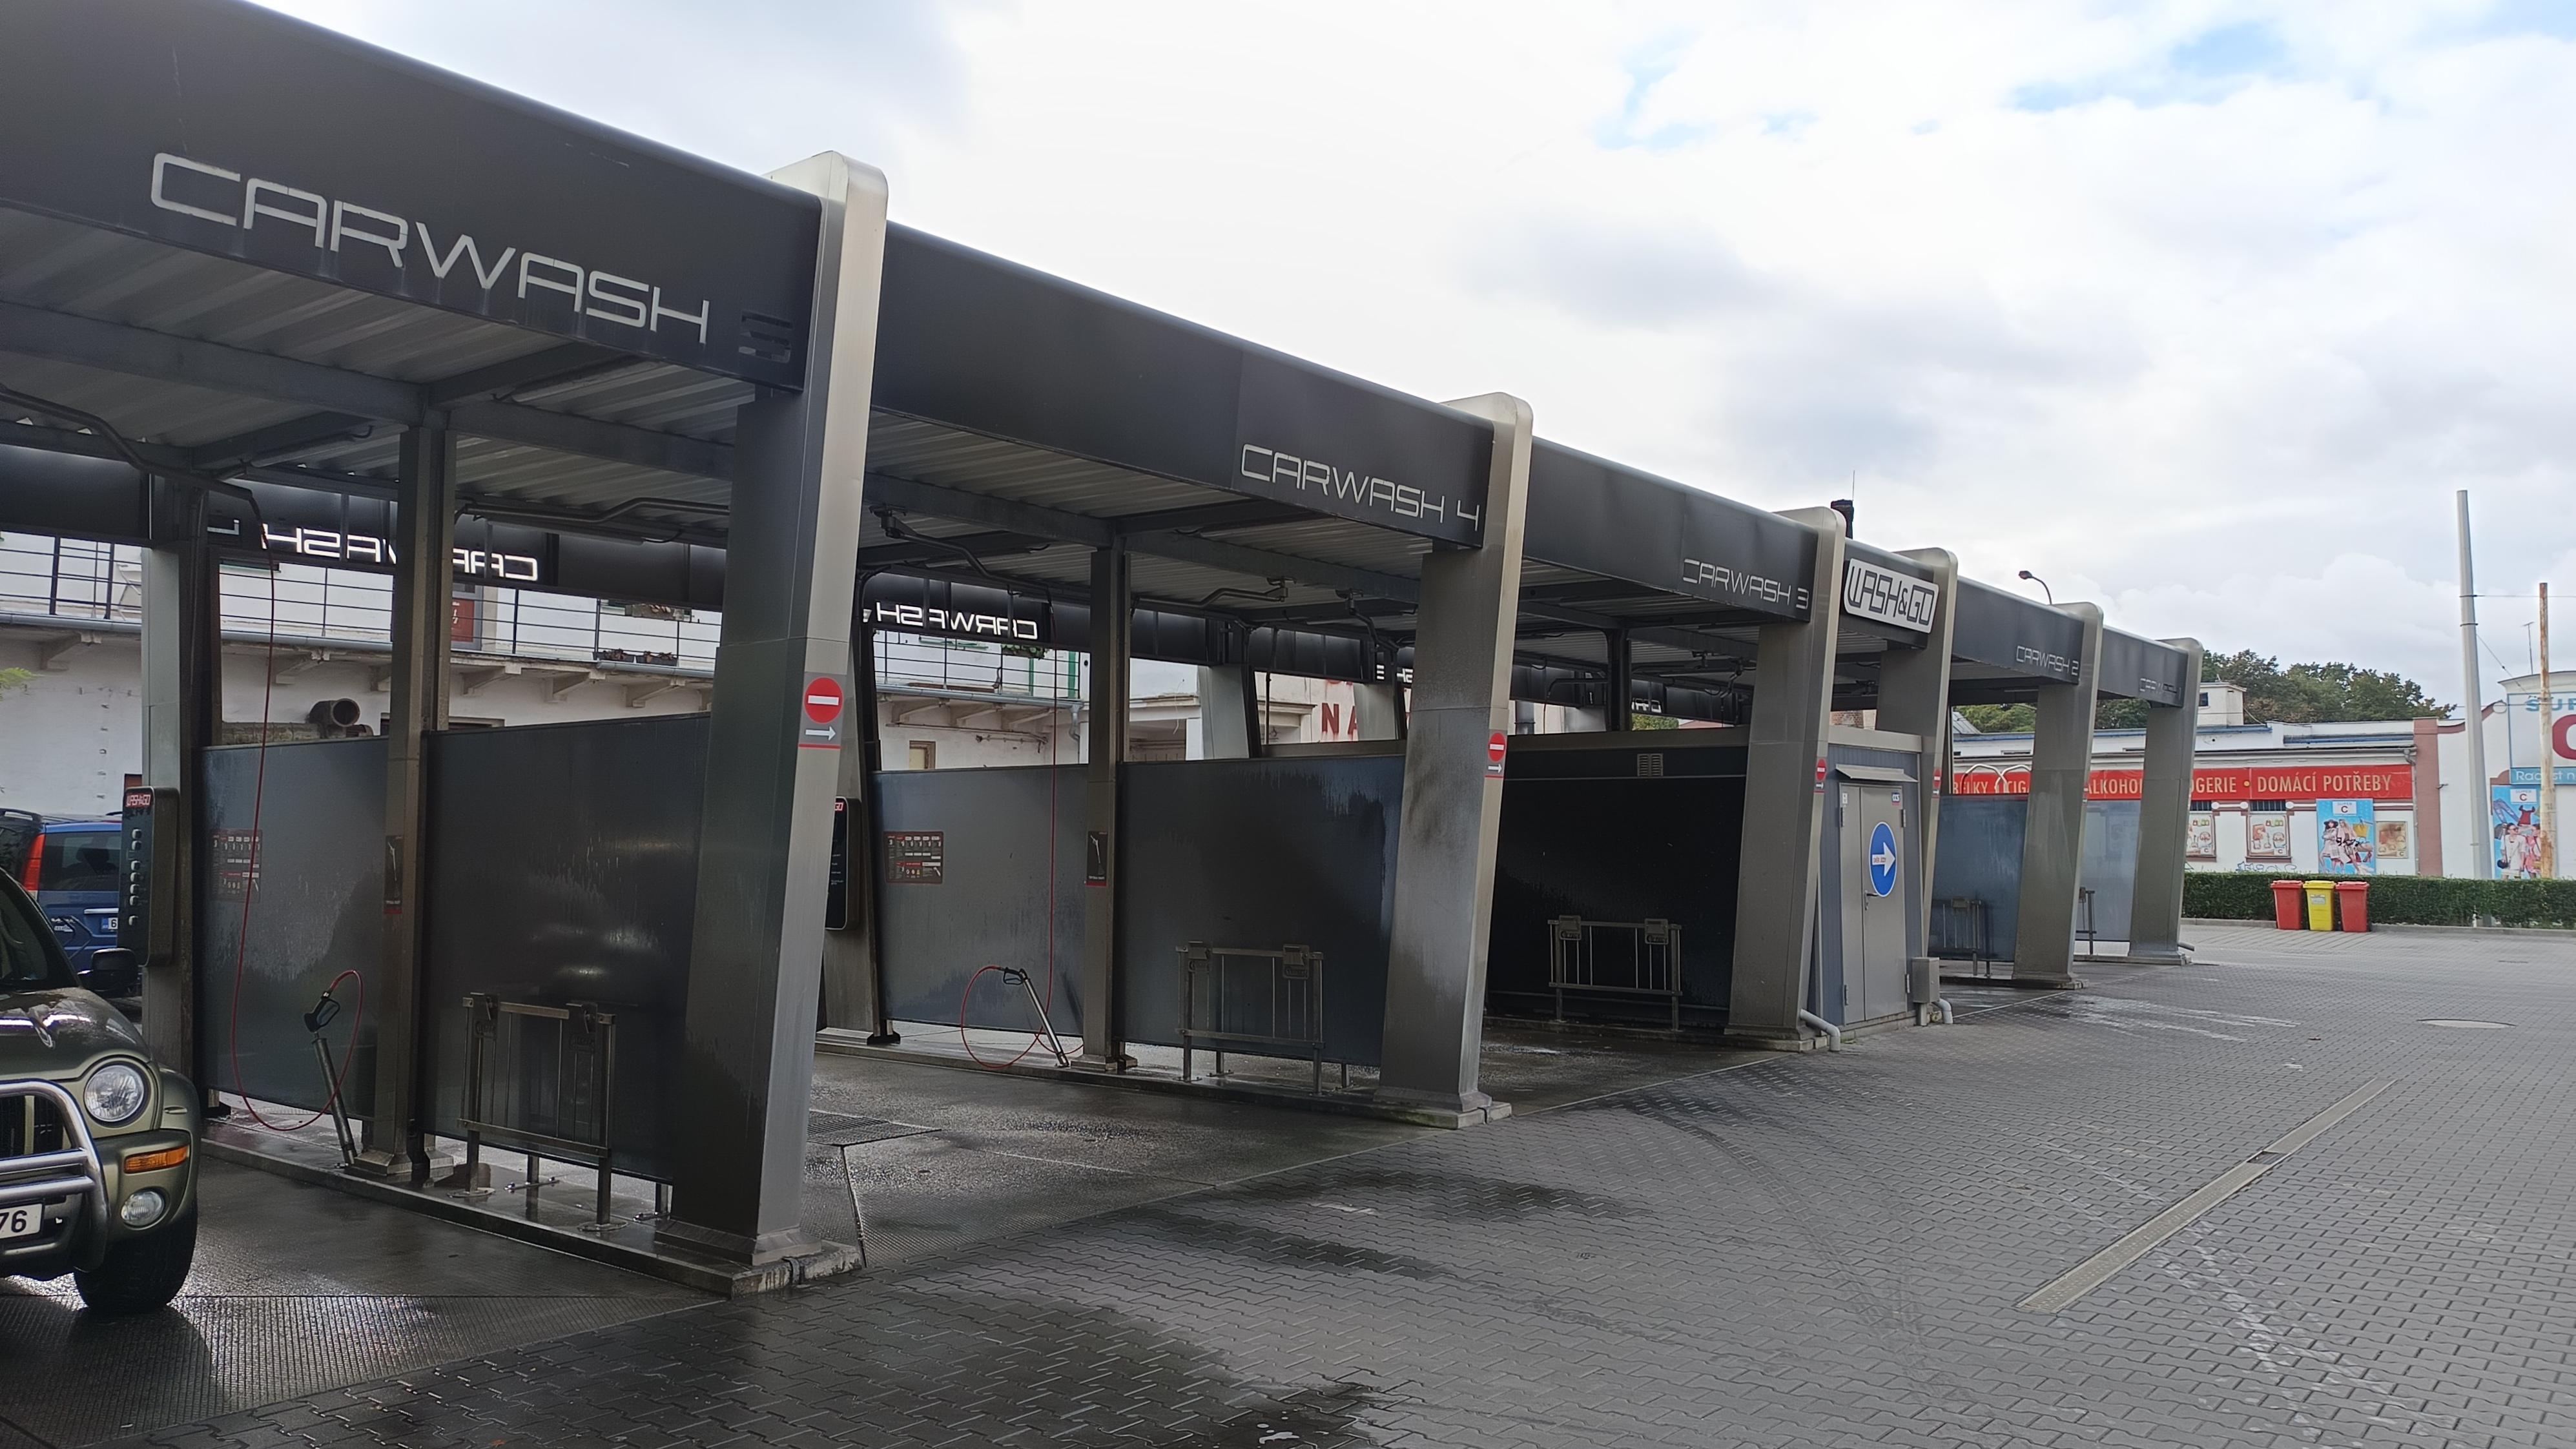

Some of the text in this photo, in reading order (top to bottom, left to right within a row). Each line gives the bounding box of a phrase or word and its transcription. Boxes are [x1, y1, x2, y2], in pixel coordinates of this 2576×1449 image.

[150, 152, 710, 344] CARWASH
[1241, 444, 1479, 531] CARWASH 4
[1683, 559, 1809, 610] CARWASH 3
[1847, 565, 1935, 626] WASH&GO
[2016, 645, 2079, 675] CARWASH 2
[2258, 772, 2316, 792] DOMÁCÍ
[2323, 771, 2391, 792] POTŘEBY
